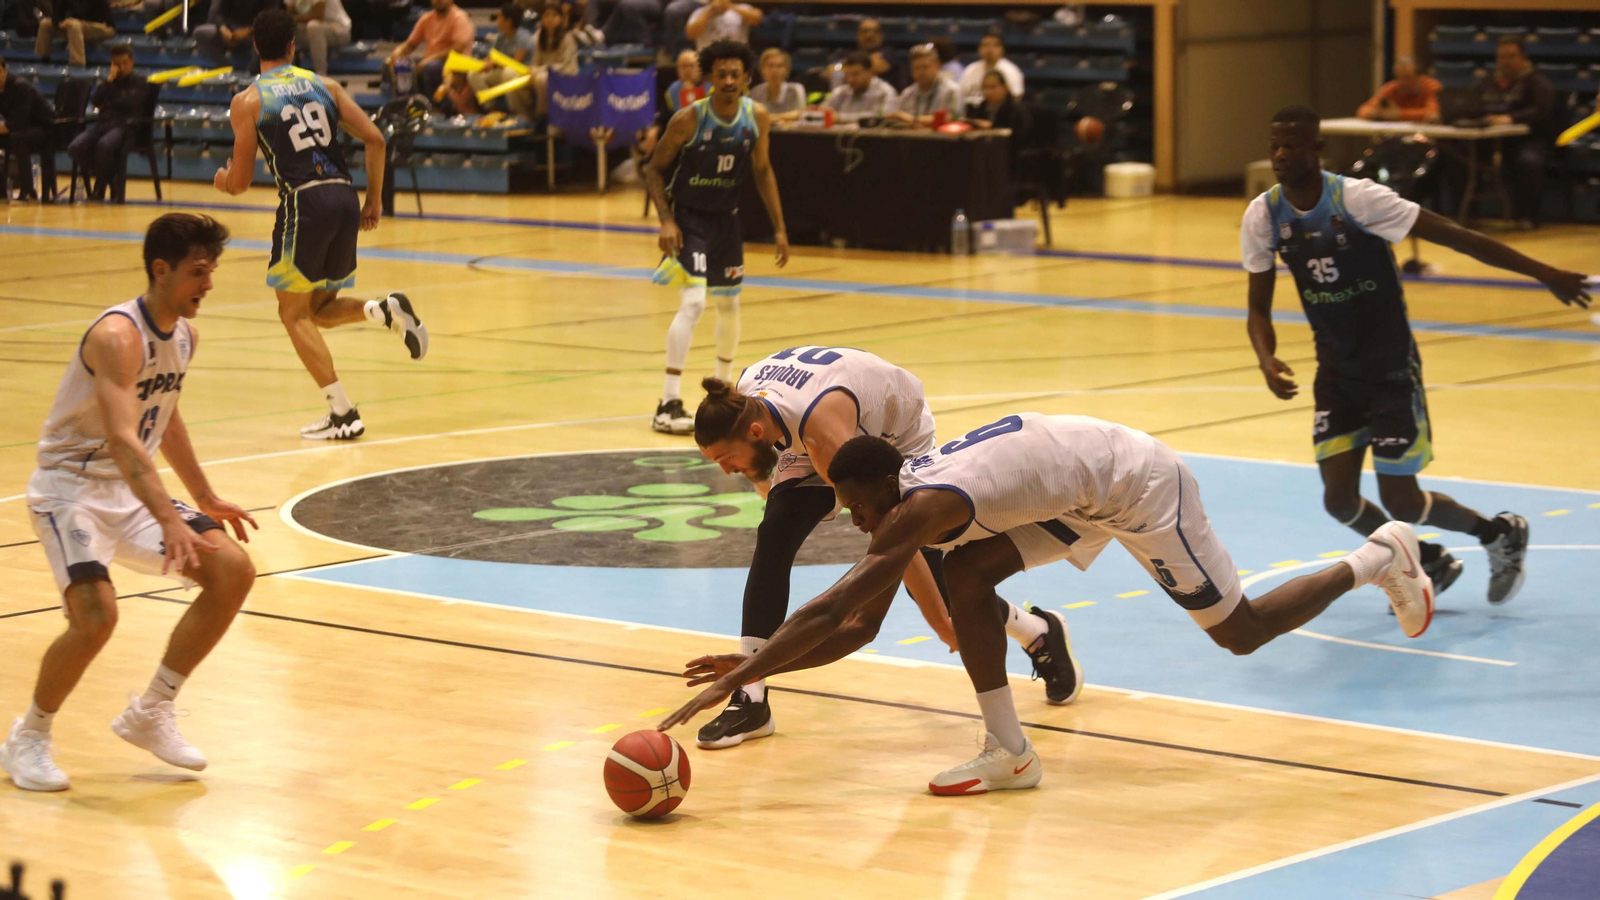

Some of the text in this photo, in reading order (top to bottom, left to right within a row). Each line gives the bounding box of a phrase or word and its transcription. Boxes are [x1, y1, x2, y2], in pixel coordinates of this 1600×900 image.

[280, 101, 332, 153] 29
[716, 154, 736, 174] 10
[692, 251, 707, 273] 10
[1306, 256, 1340, 284] 35
[753, 364, 814, 391] ARQUÉS
[1149, 558, 1178, 588] 6
